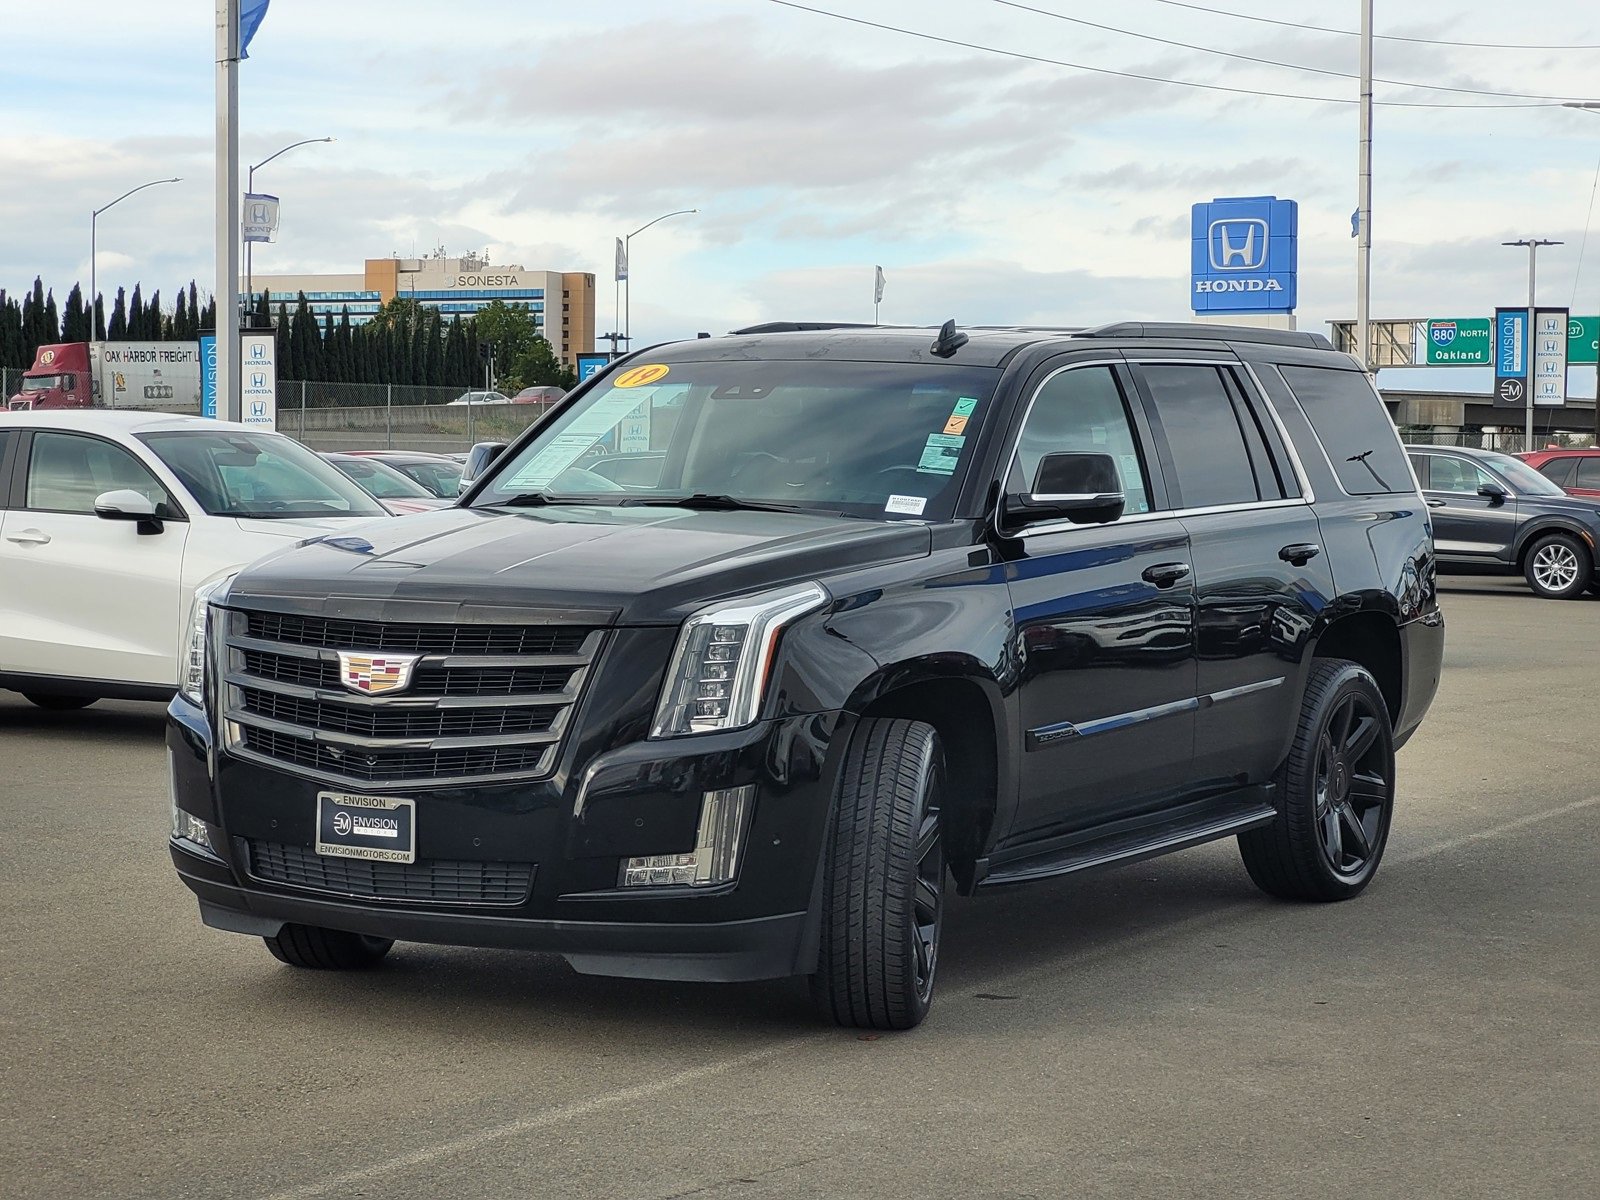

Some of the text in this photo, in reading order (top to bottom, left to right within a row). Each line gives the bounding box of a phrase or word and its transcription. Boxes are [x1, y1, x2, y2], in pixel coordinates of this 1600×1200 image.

[458, 275, 519, 287] SONESTA
[1195, 279, 1283, 293] HONDA
[1433, 329, 1488, 341] 880 NORTH
[1503, 317, 1514, 372] ENVISION
[105, 350, 121, 363] OAK
[123, 350, 156, 363] HARBOR
[159, 350, 192, 363] FREIGHT
[1435, 350, 1481, 360] Oakland
[207, 342, 217, 417] ENVISION
[620, 367, 661, 385] 19
[343, 795, 386, 808] ENVISION
[353, 816, 398, 830] ENVISION
[320, 845, 410, 862] ENVISIONMOTORS.COM
